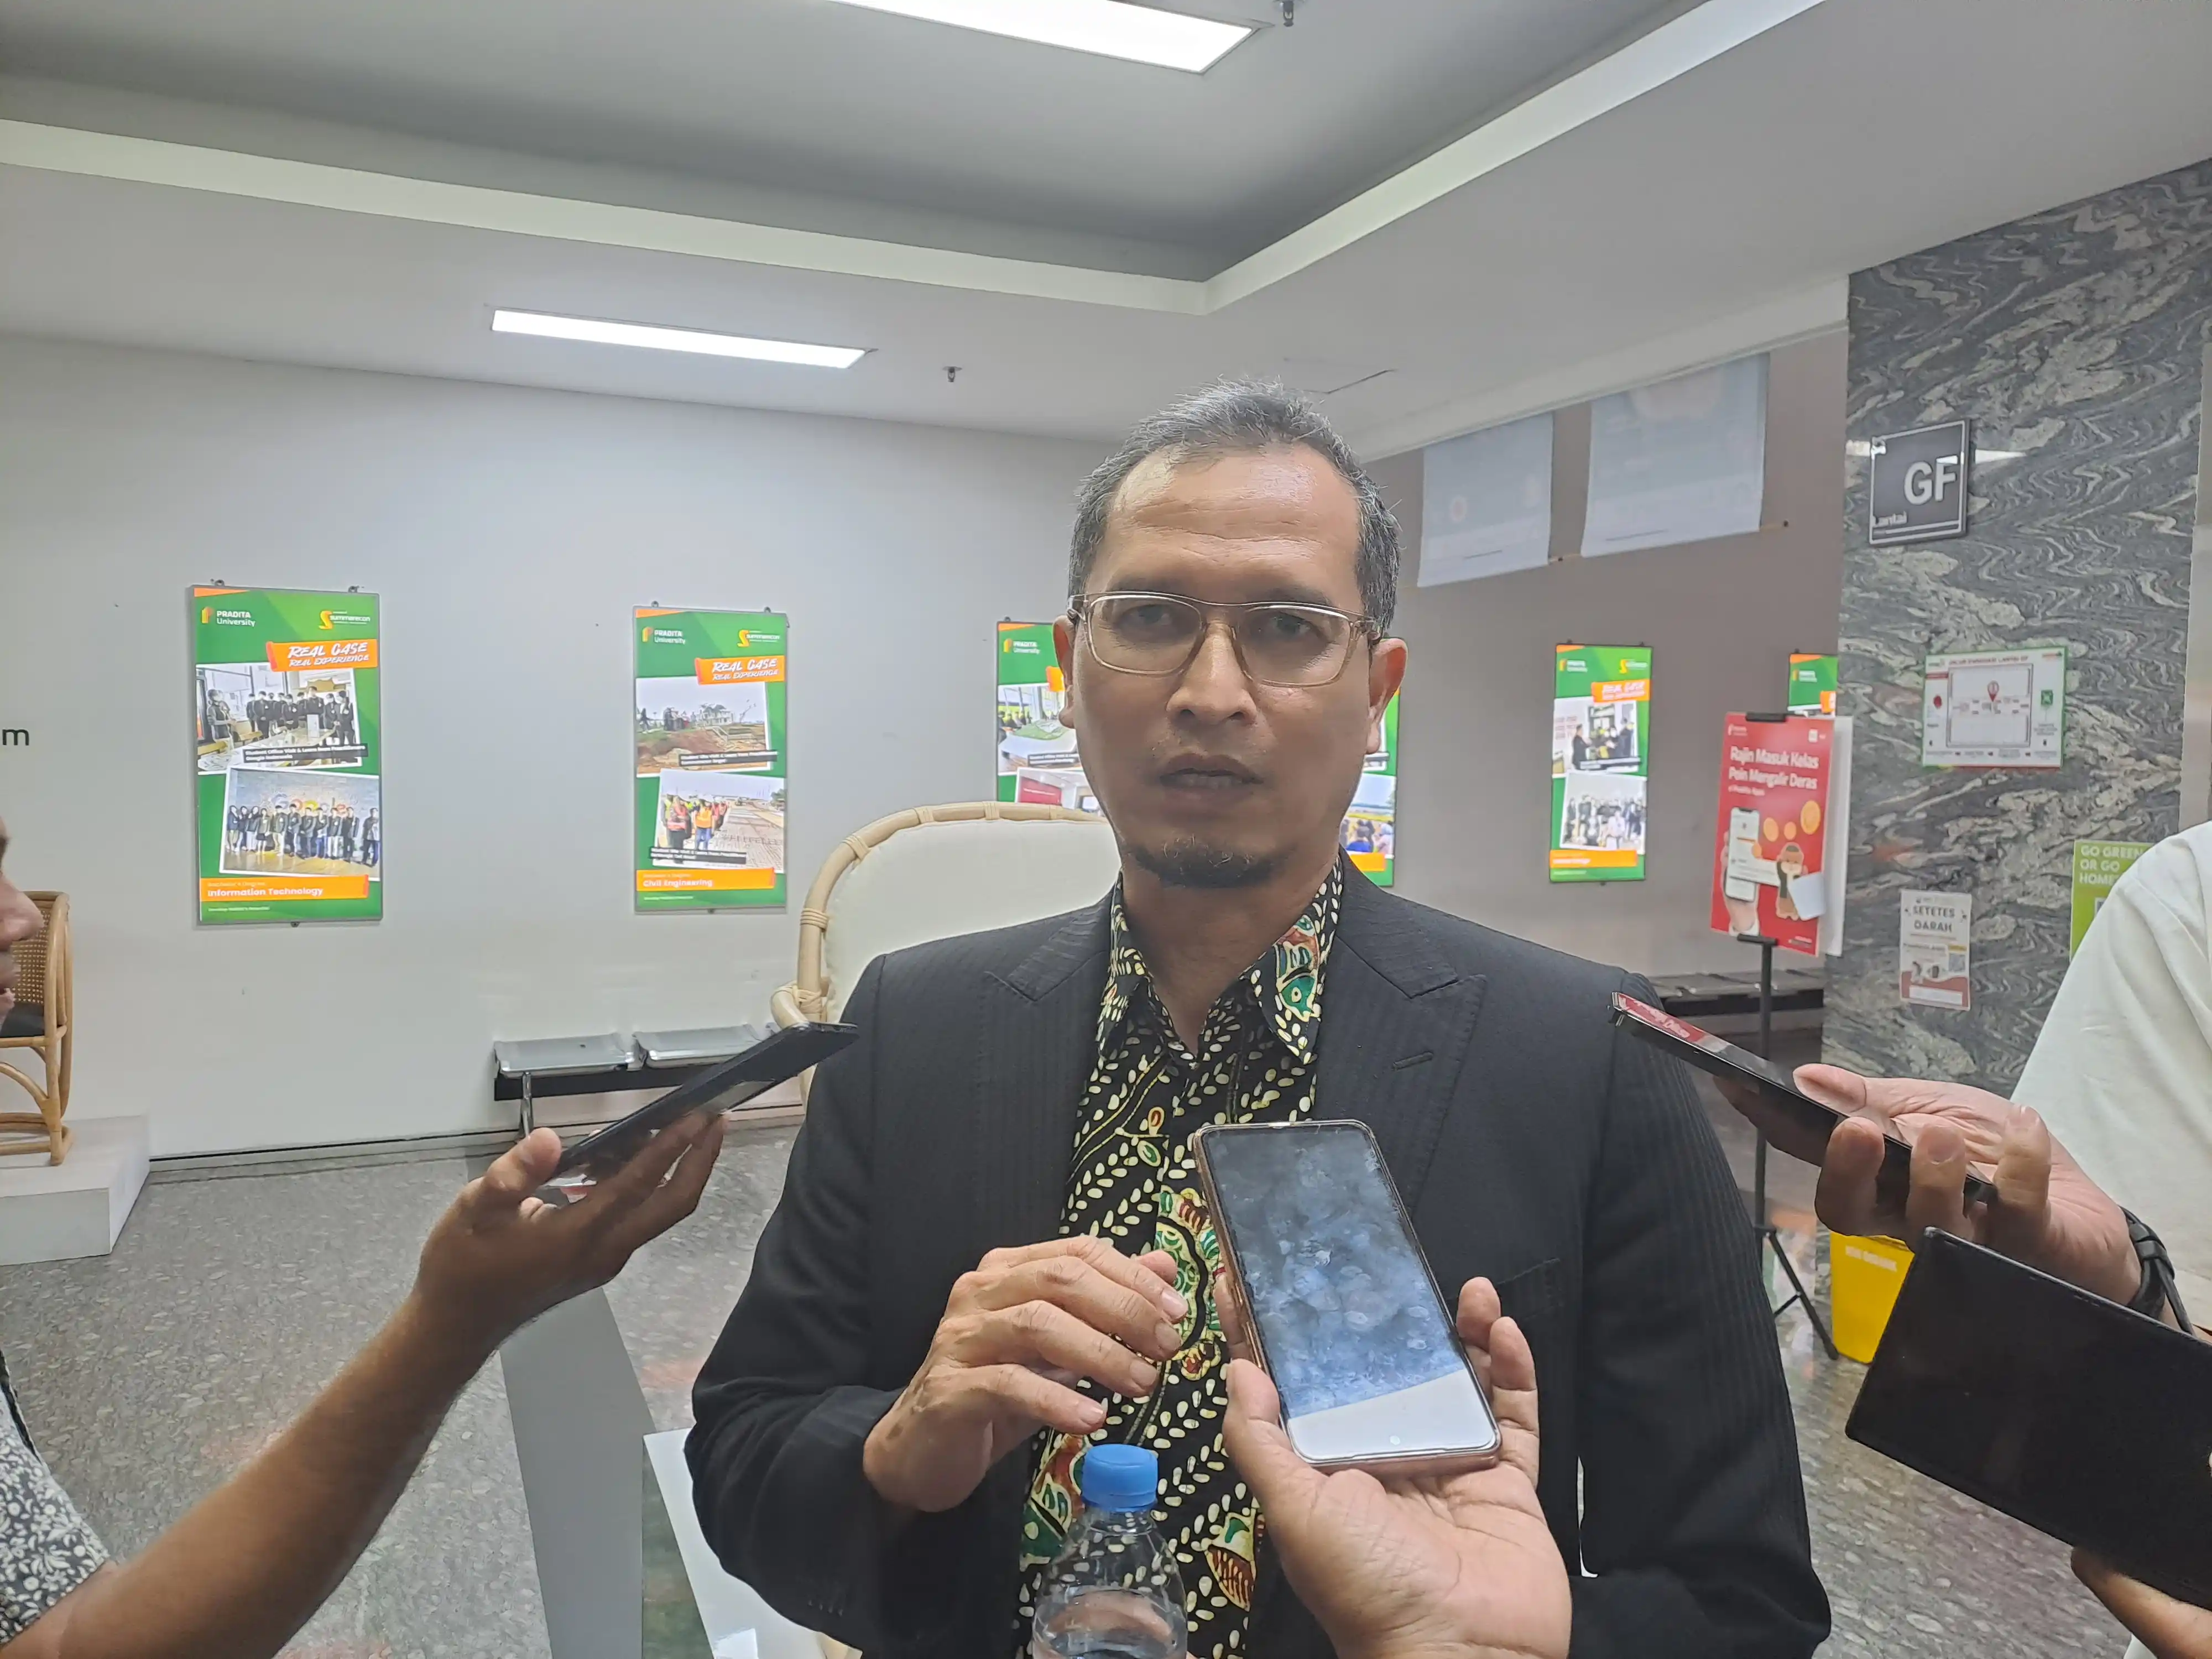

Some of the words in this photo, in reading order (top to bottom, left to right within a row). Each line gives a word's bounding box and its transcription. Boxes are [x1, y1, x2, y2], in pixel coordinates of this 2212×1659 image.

[1904, 455, 1958, 506] GF
[216, 618, 256, 627] University
[288, 645, 326, 659] REAL
[331, 642, 368, 656] CASE
[289, 659, 312, 667] REAL
[314, 654, 370, 665] EXPERIENCE
[712, 661, 743, 673] REAL
[747, 658, 778, 670] CASE
[1755, 748, 1790, 766] Masuk
[1790, 752, 1819, 769] Kelas
[1789, 773, 1818, 790] Deras
[2081, 845, 2100, 857] GO
[2080, 858, 2098, 870] OR
[2100, 860, 2120, 872] GO
[664, 879, 713, 889] Engineering
[208, 889, 266, 897] Information
[268, 887, 324, 896] Technology
[1912, 905, 1955, 919] SETETES
